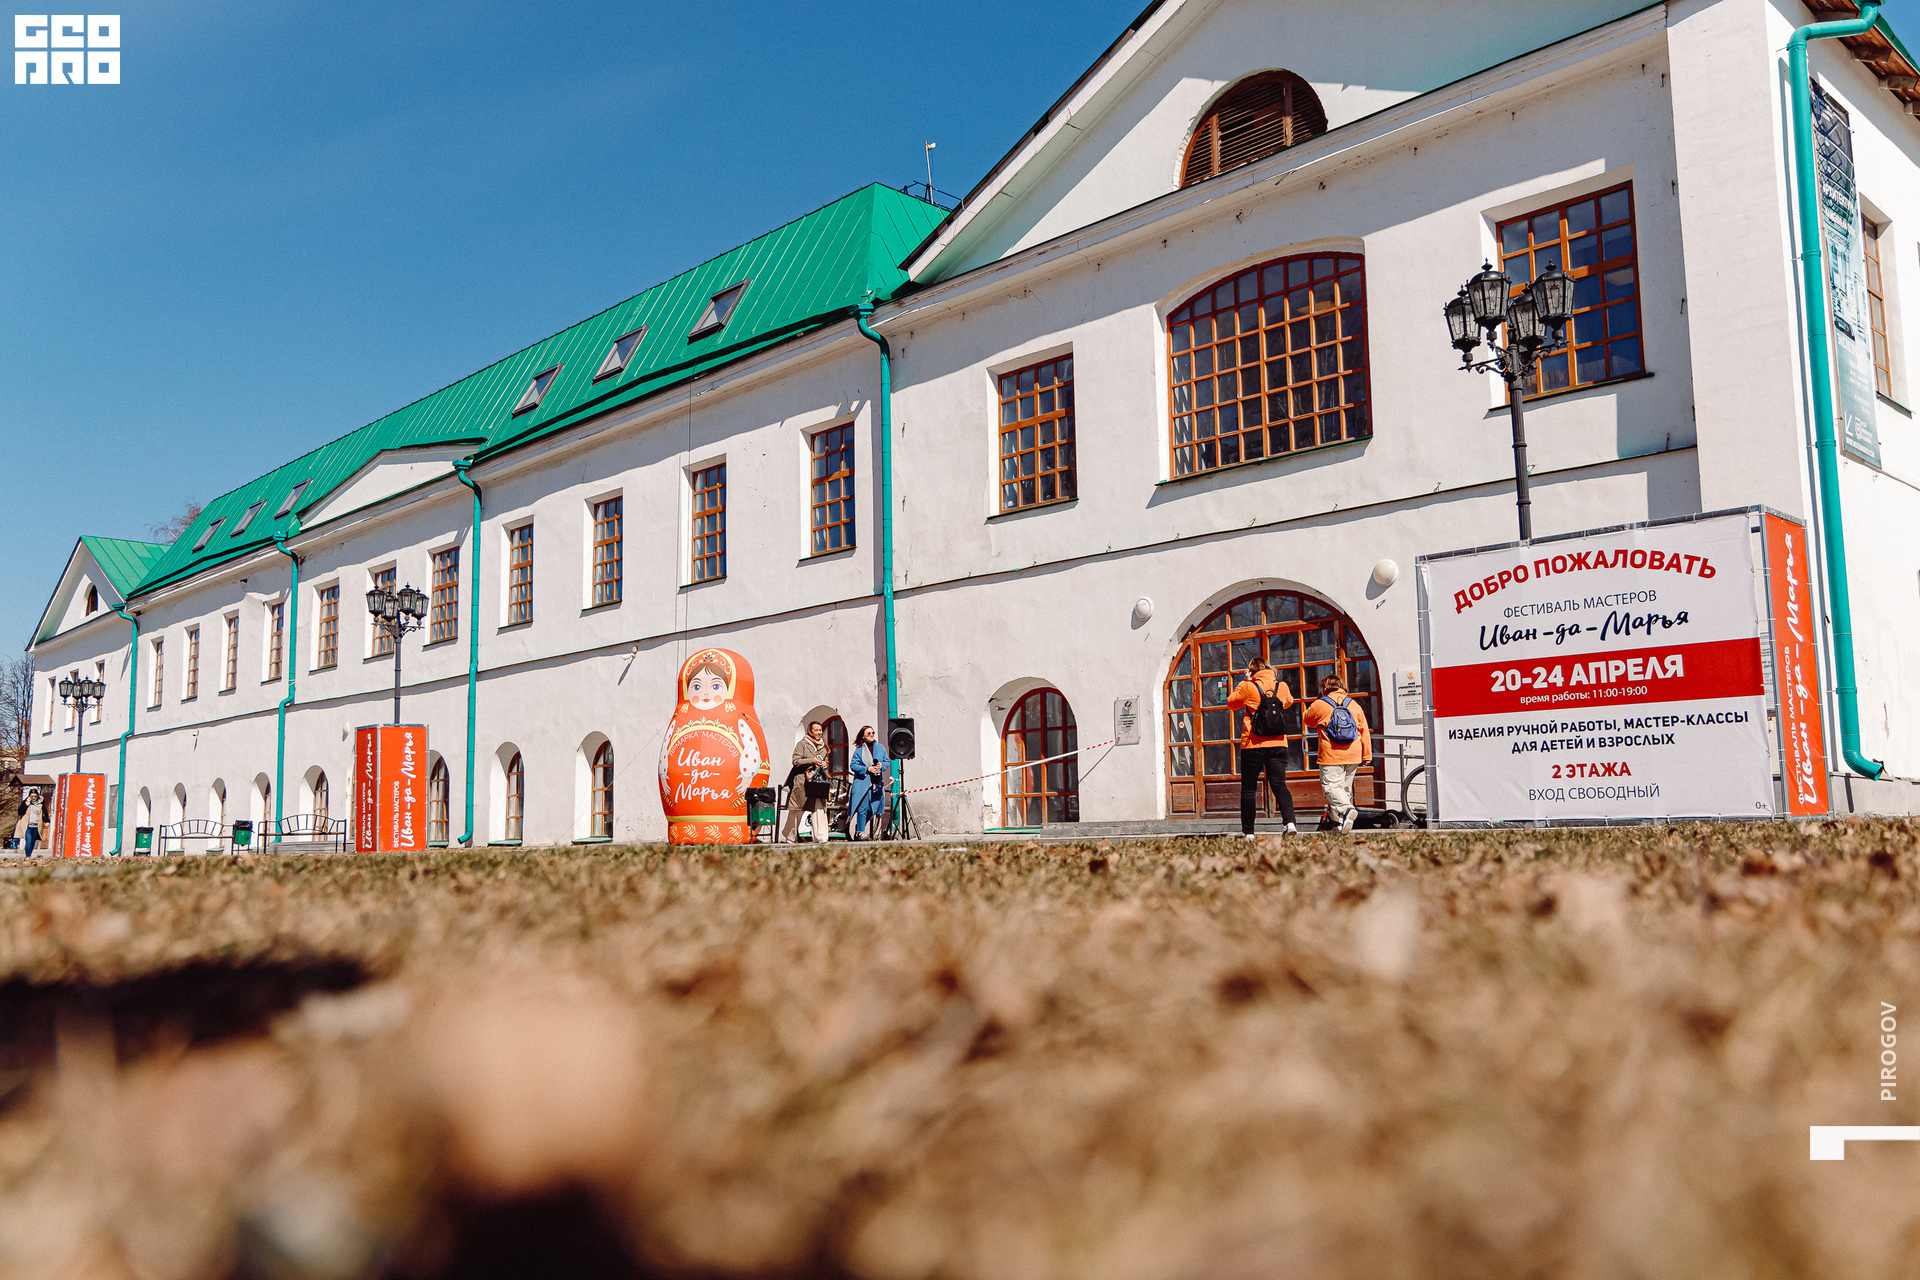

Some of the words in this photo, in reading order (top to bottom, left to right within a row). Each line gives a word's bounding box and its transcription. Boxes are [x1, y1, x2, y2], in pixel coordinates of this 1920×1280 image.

[1453, 565, 1529, 614] ДОБРО
[1533, 549, 1717, 579] ПОЖАЛОВАТЬ
[1503, 600, 1580, 618] ФЕСТИВАЛЬ
[1583, 589, 1657, 609] МАСТЕРОВ
[1490, 665, 1564, 692] 20-24
[1569, 654, 1684, 686] АПРЕЛЯ
[1784, 646, 1796, 720] МАСТЕРОВ
[1520, 694, 1550, 705] время
[1551, 691, 1591, 703] работы:
[1592, 685, 1648, 698] 11:00-19:00
[1448, 726, 1504, 741] ИЗДЕЛИЯ
[1507, 719, 1558, 736] РУЧНОЙ
[1561, 719, 1621, 733] РАБОТЫ,
[1624, 710, 1749, 730] МАСТЕР-КЛАССЫ
[669, 731, 699, 757] ЯРМАРКА
[701, 731, 740, 758] МАСТЕРОВ
[677, 747, 726, 766] Иван
[1512, 741, 1537, 754] ДЛЯ
[1540, 735, 1583, 752] ДЕТЕЙ
[1586, 738, 1595, 748] И
[1599, 733, 1675, 748] ВЗРОСЛЫХ
[1551, 764, 1562, 779] 2
[1565, 761, 1632, 778] ЭТАЖА
[1789, 723, 1805, 805] ФЕСТИВАЛЬ
[674, 782, 733, 803] Марья
[1528, 788, 1565, 802] ВХОД
[1568, 783, 1660, 800] СВОБОДНЫЙ
